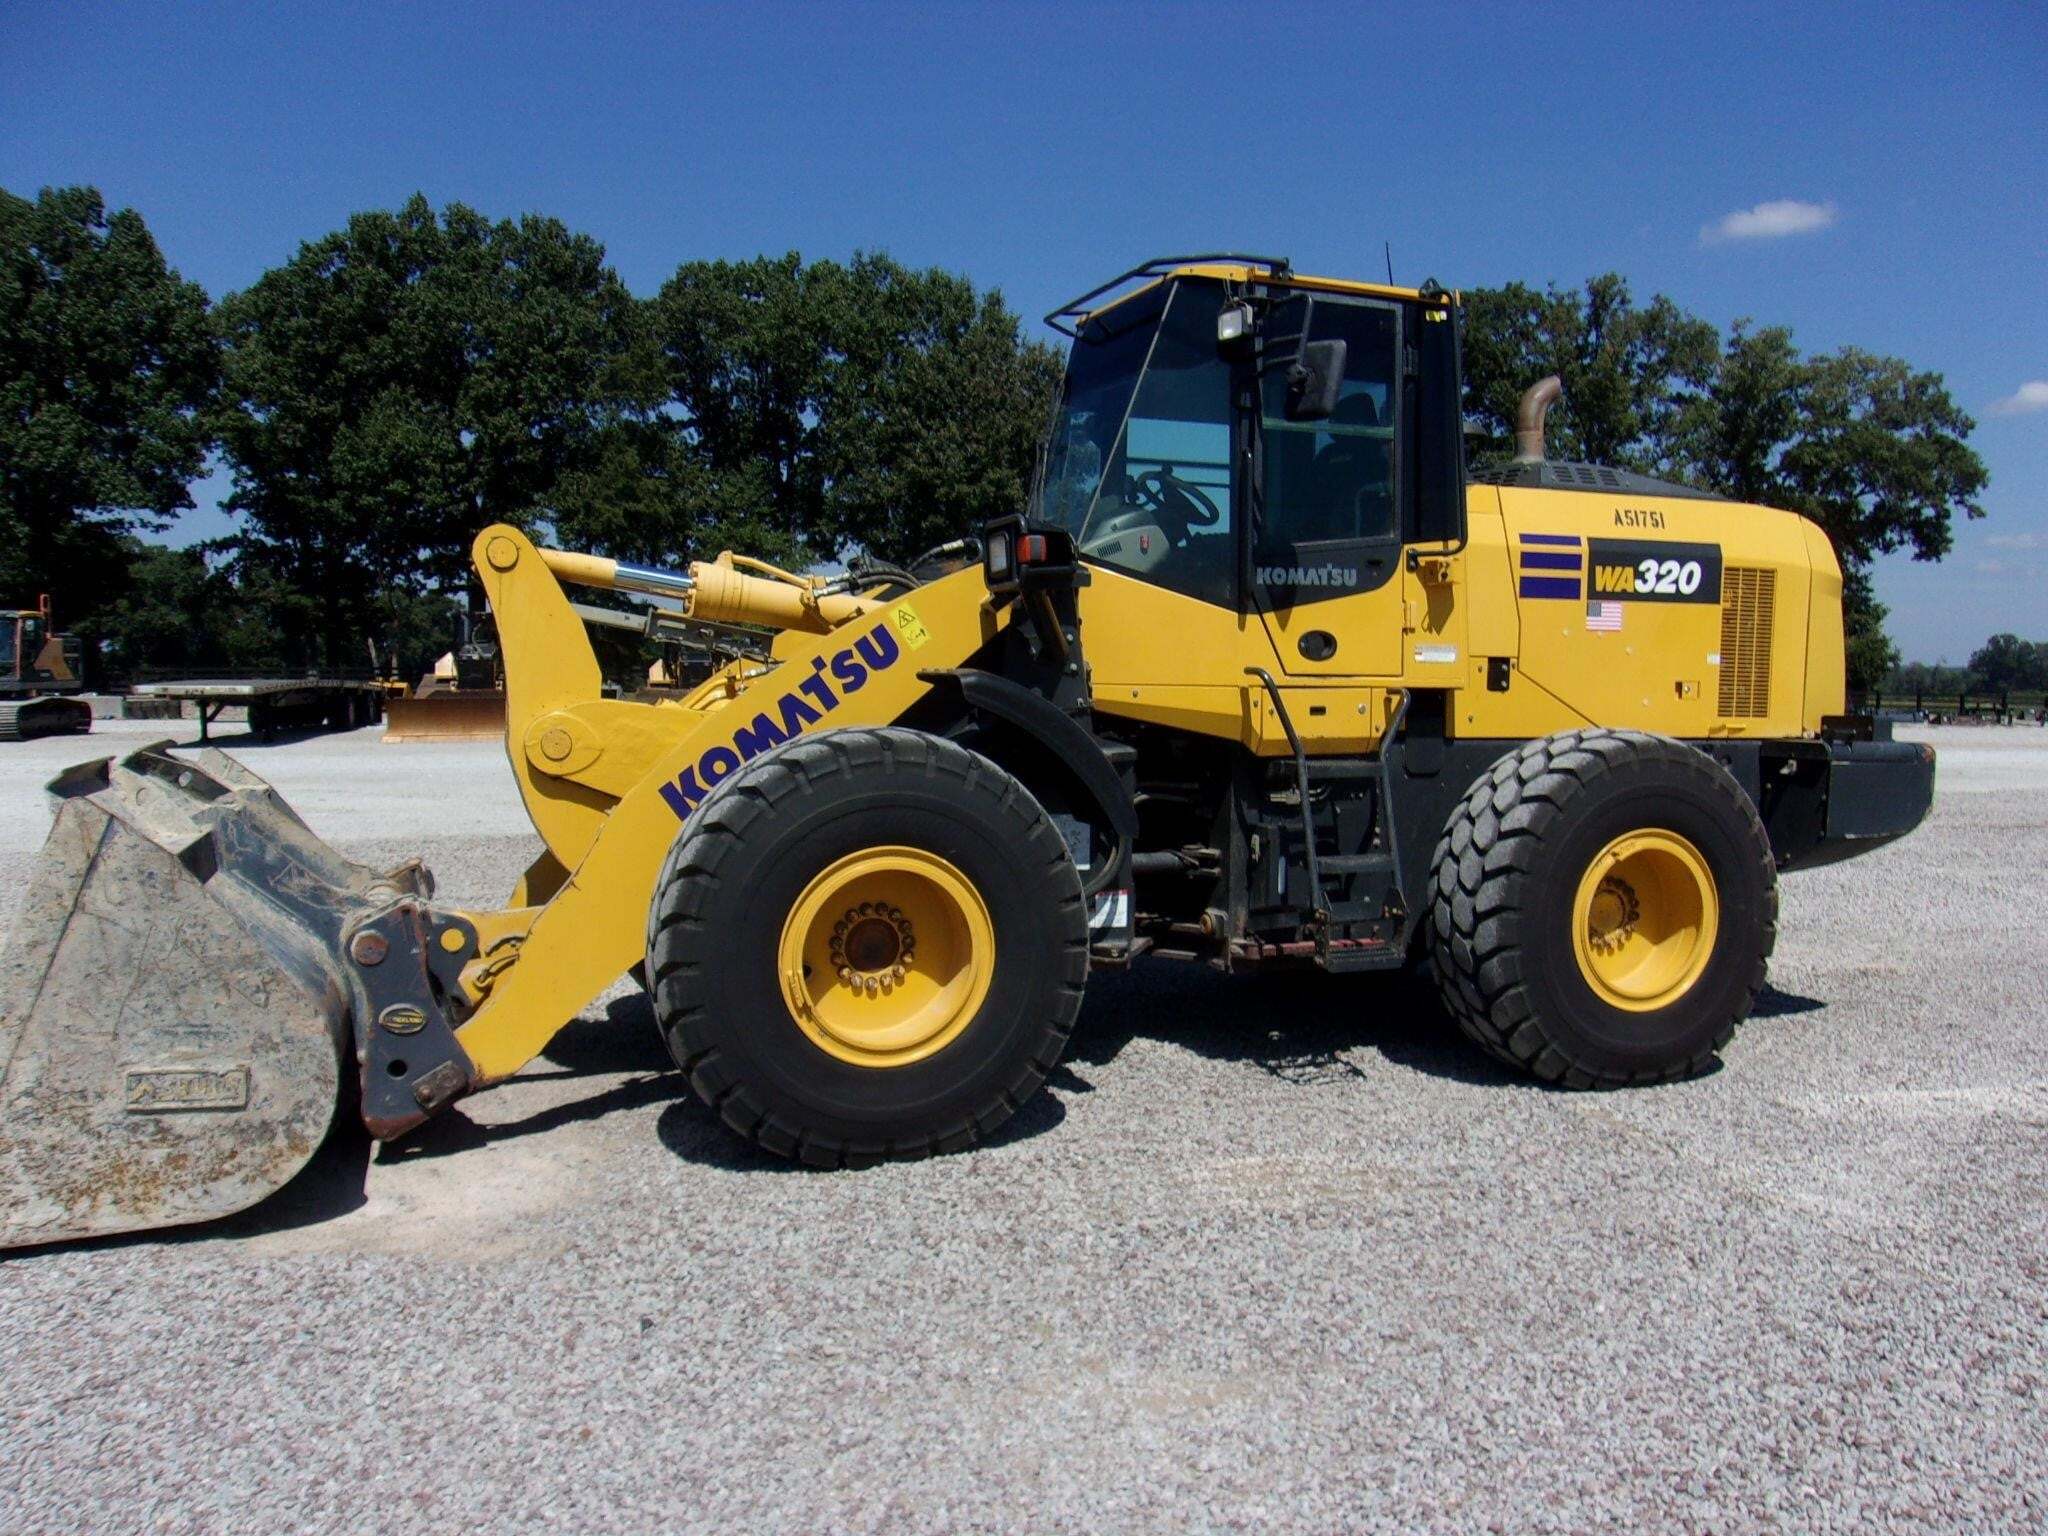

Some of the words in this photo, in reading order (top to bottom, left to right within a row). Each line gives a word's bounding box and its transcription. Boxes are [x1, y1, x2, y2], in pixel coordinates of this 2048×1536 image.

[1613, 508, 1666, 530] A51751
[1256, 562, 1357, 587] KOMATSU
[1594, 558, 1702, 595] WA320
[658, 623, 900, 822] KOMATSU
